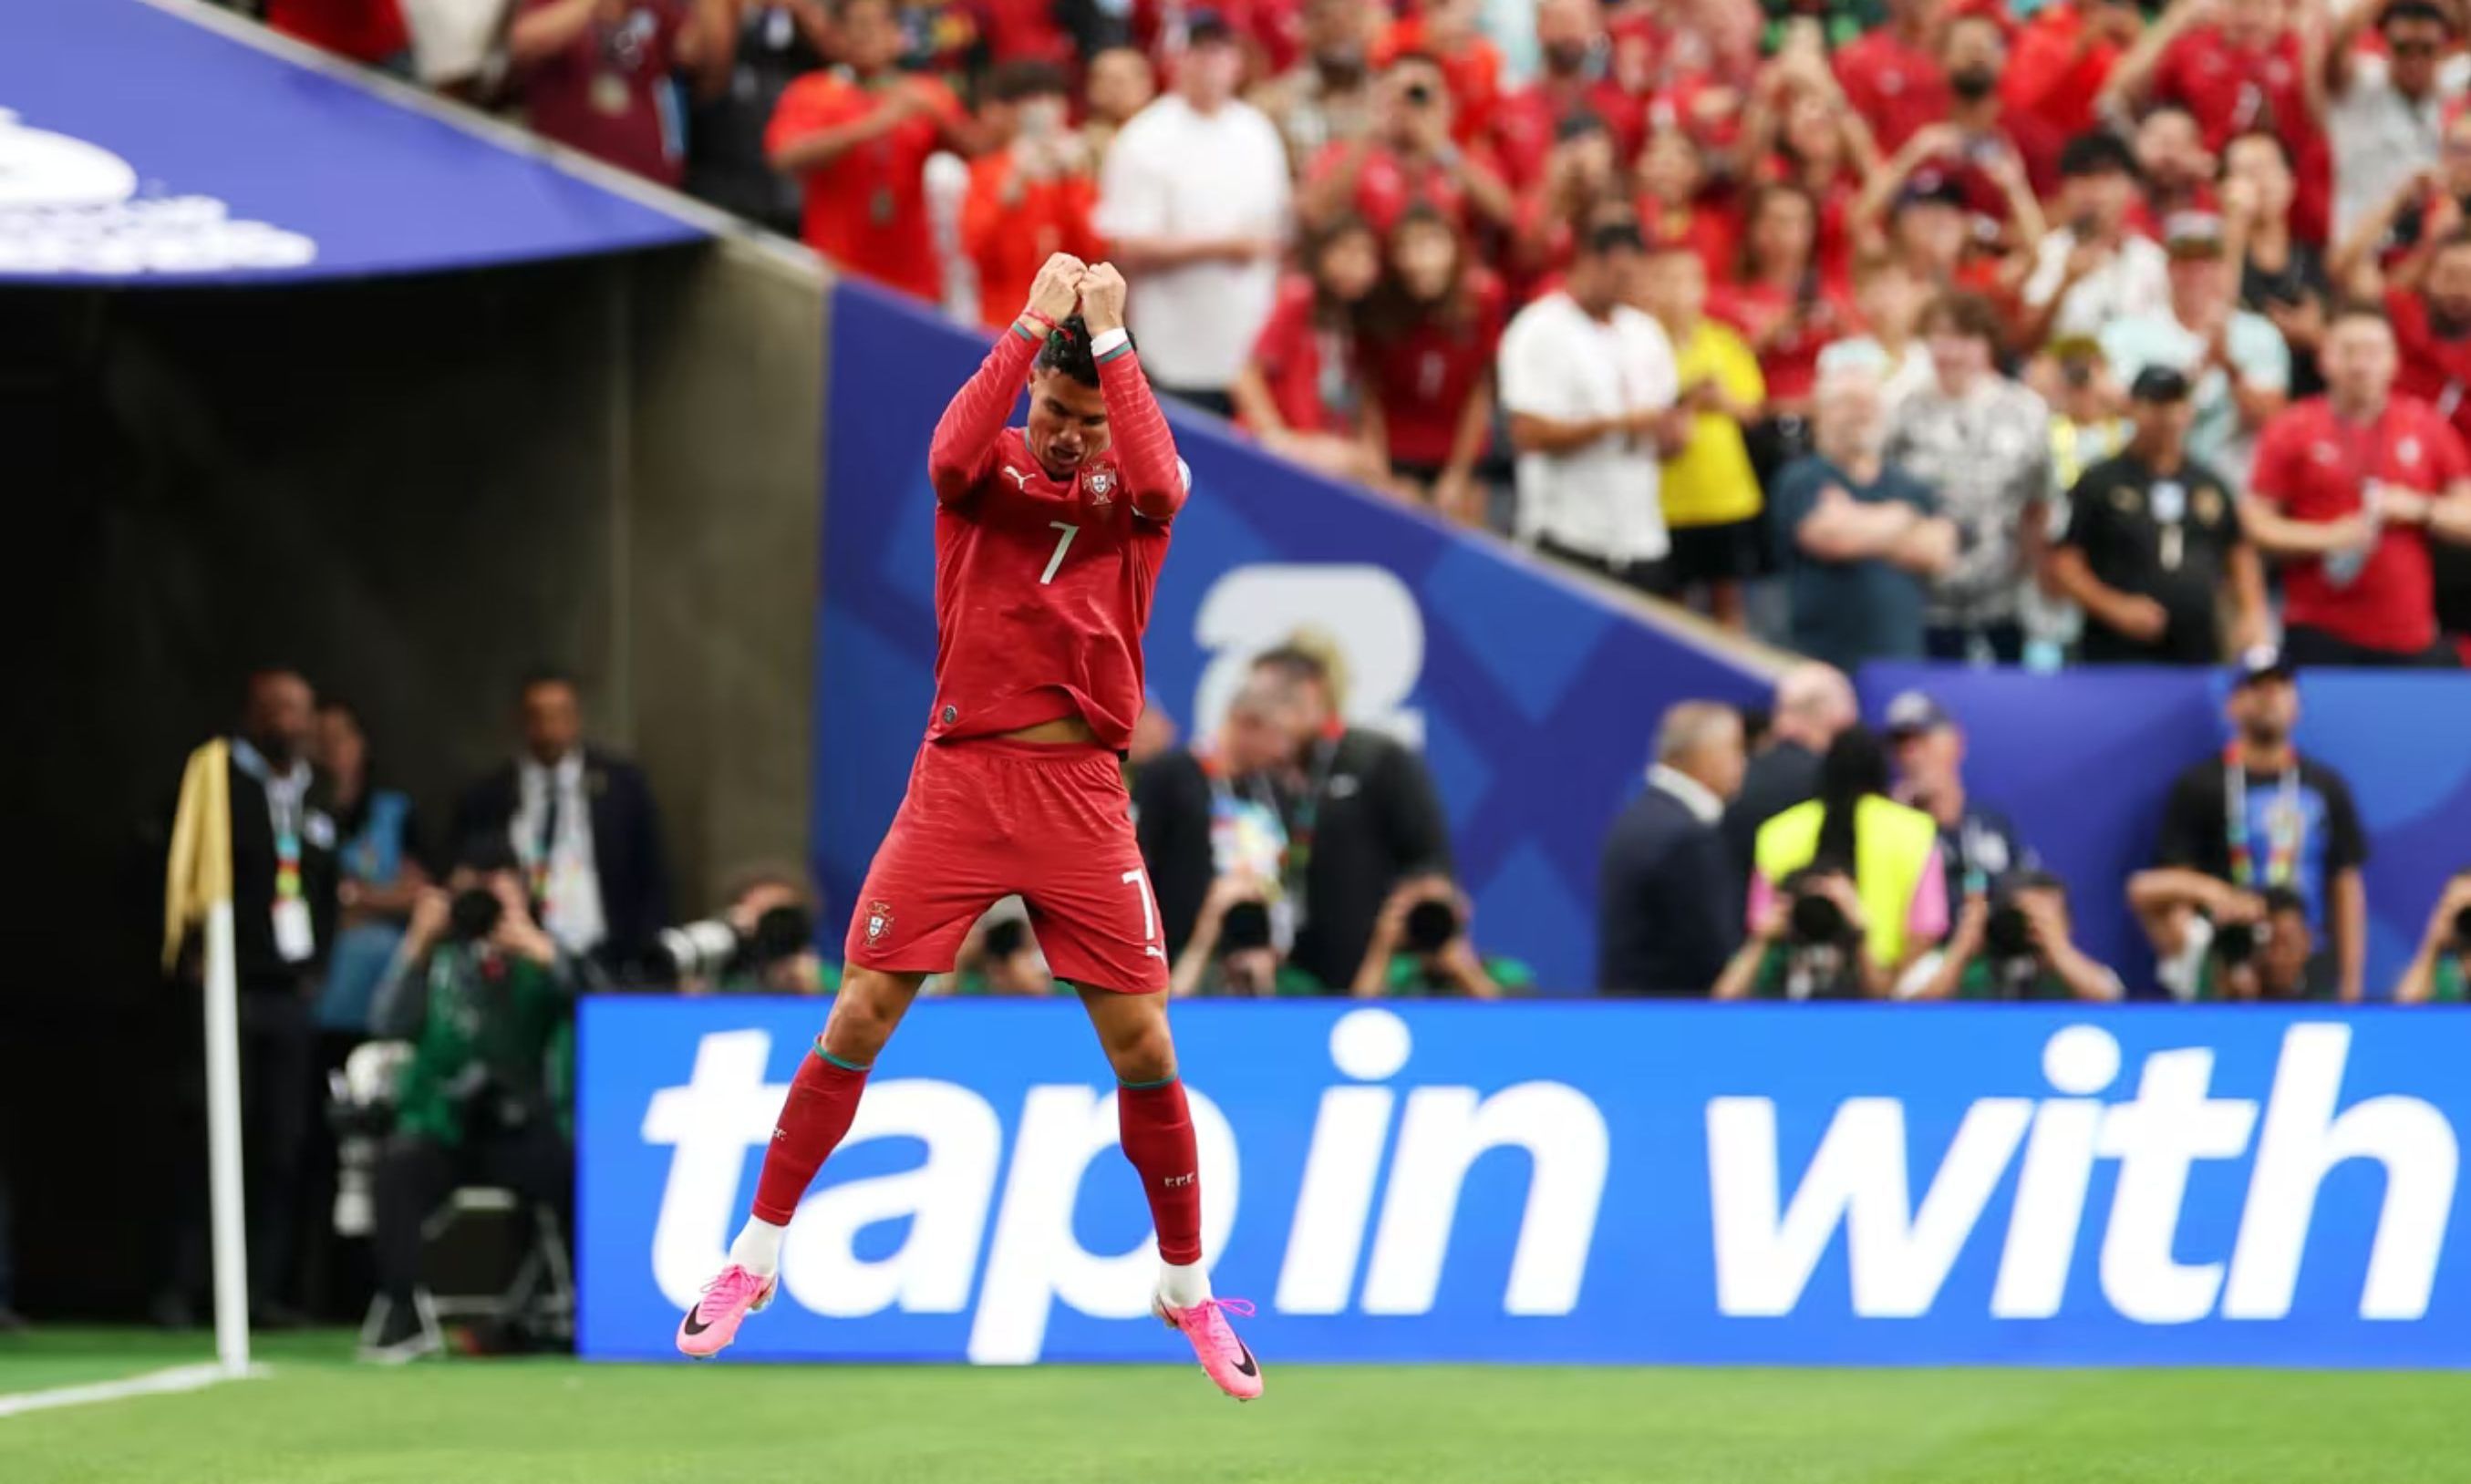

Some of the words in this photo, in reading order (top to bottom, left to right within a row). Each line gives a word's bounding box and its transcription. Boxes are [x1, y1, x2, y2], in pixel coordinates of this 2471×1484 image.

[1039, 520, 1080, 585] 7
[1122, 868, 1155, 940] 7
[641, 1028, 1241, 1365] tap
[1274, 1008, 1609, 1316] in
[1705, 1021, 2459, 1324] with
